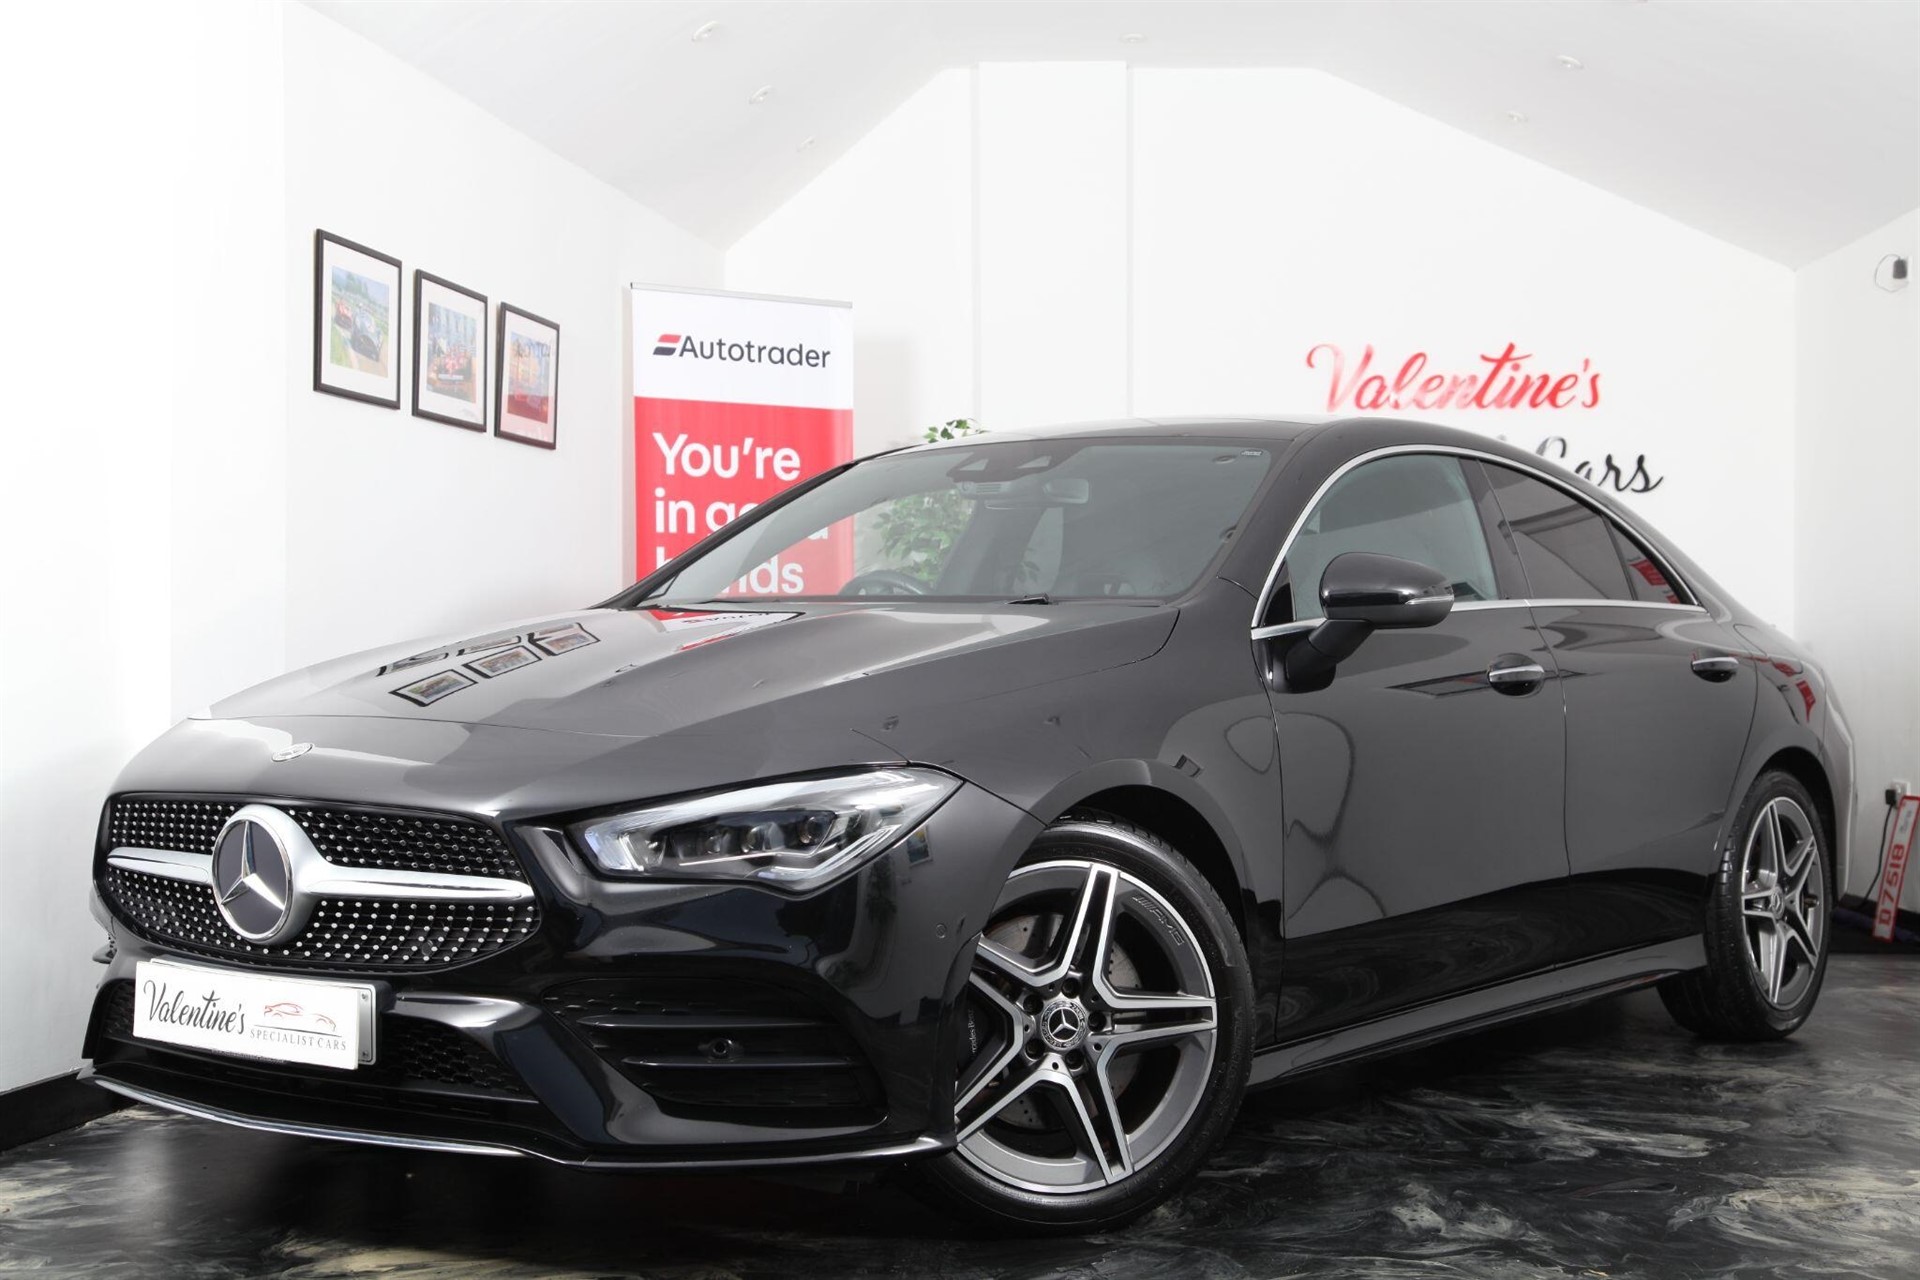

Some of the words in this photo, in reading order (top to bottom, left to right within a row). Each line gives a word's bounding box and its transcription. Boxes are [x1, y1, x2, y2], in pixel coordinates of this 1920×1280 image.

[679, 335, 831, 368] Autotrader
[1306, 342, 1600, 413] Valentine's
[653, 432, 801, 481] You're
[655, 487, 695, 534] in
[143, 979, 246, 1035] Valentine's
[250, 1029, 314, 1046] SPECIALIST
[318, 1037, 346, 1051] CARS
